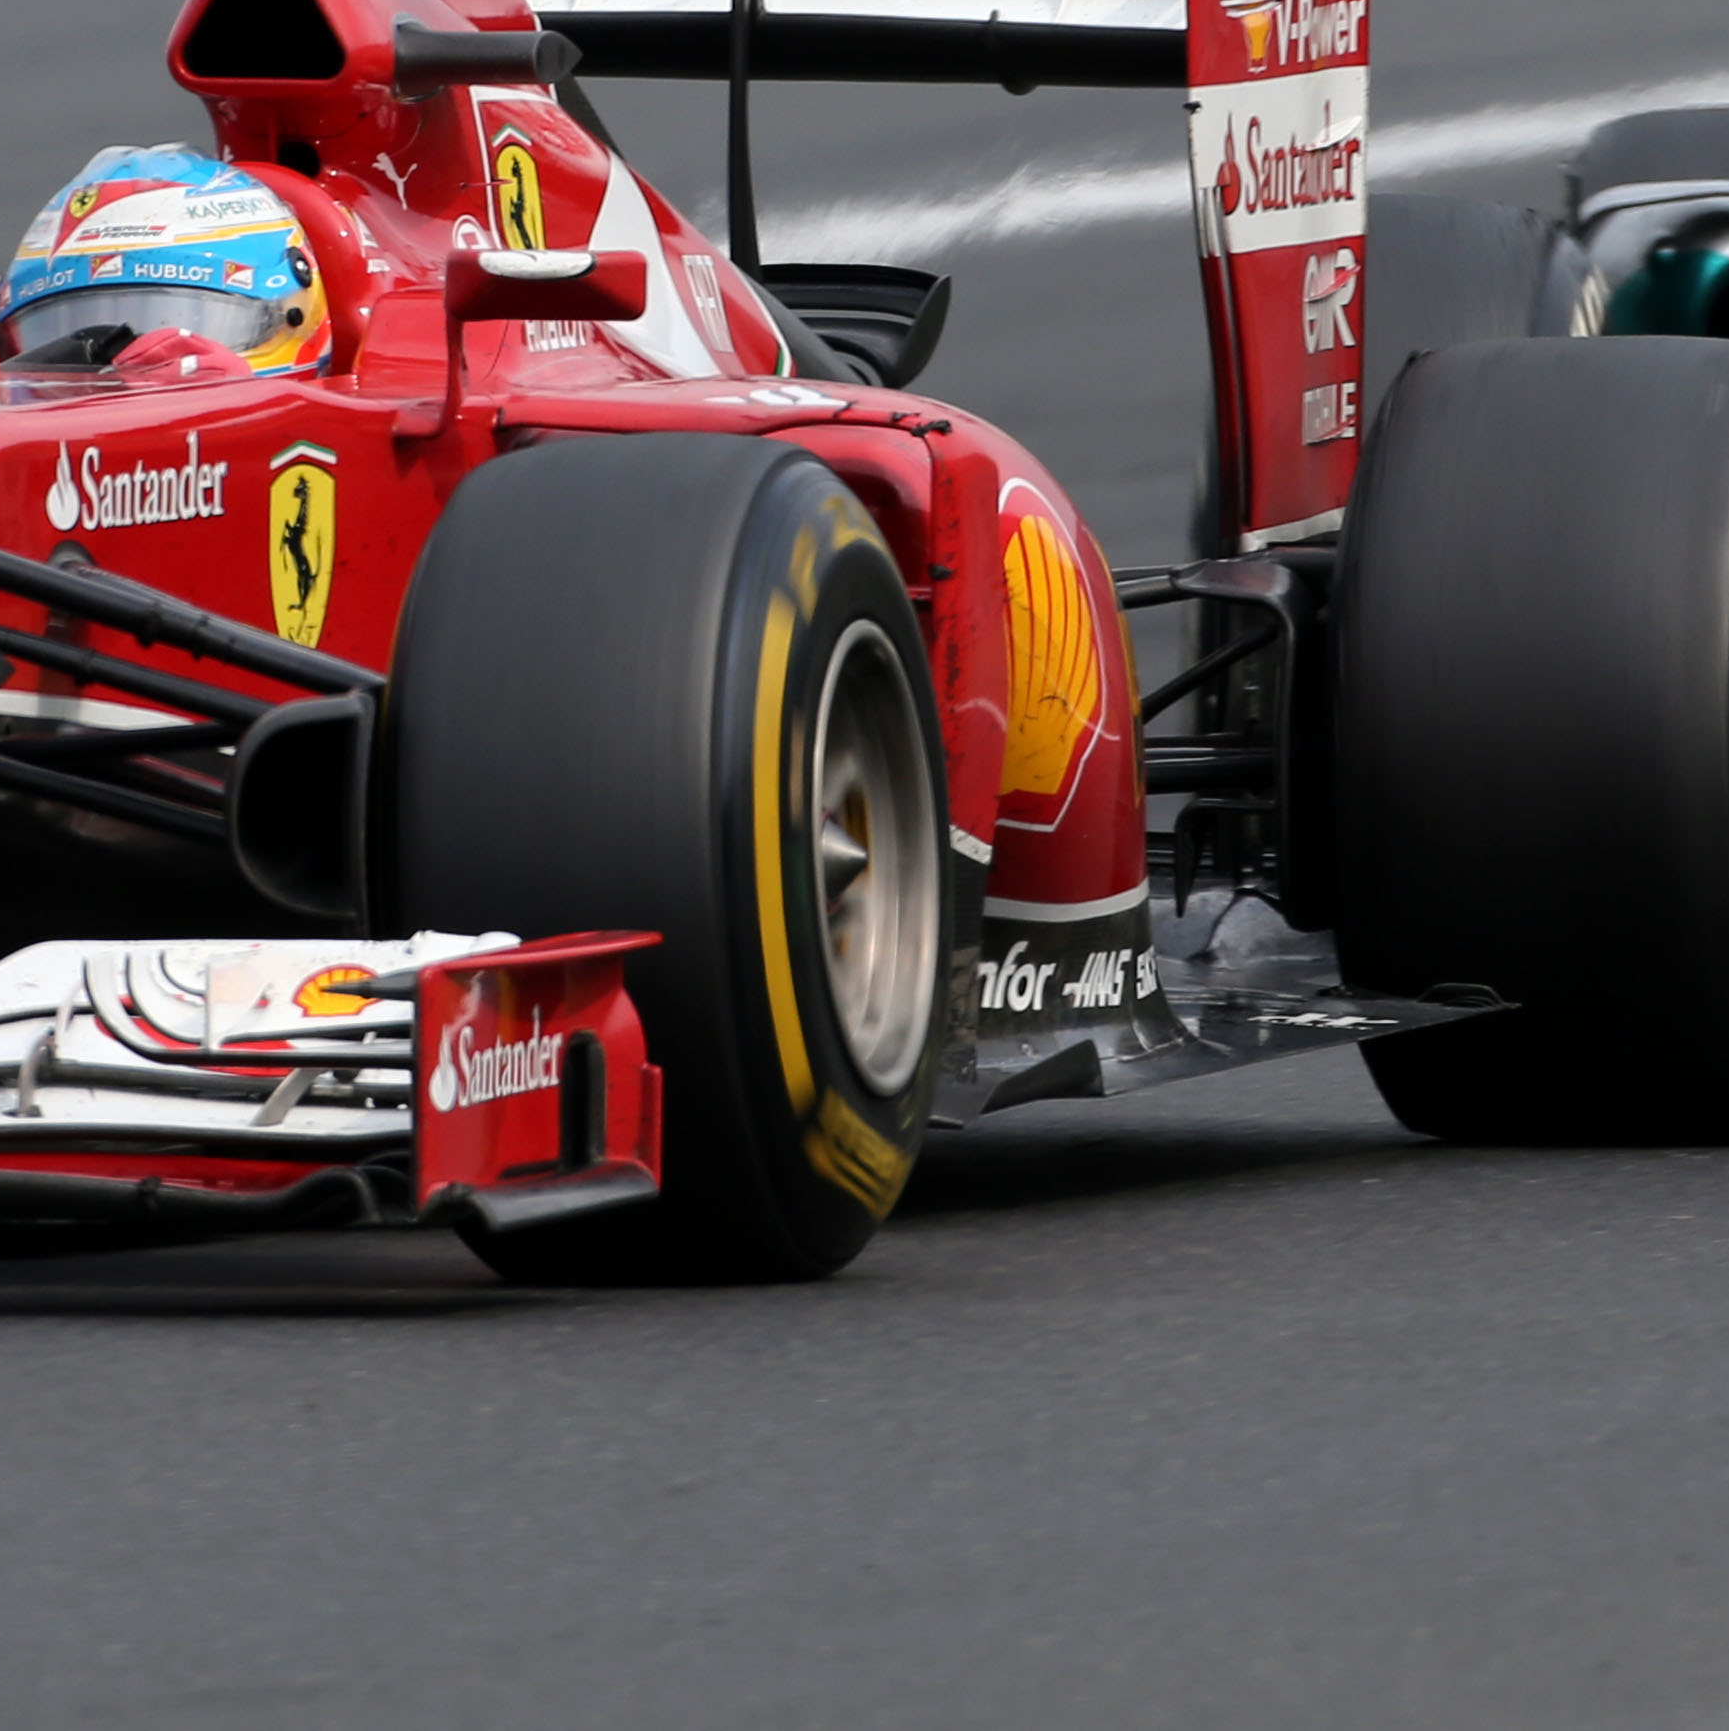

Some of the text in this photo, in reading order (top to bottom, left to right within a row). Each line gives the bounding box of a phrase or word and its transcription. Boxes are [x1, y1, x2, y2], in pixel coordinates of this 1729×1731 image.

[133, 263, 214, 283] HUBLOT
[80, 429, 229, 532] Santander
[458, 1003, 563, 1108] Santander
